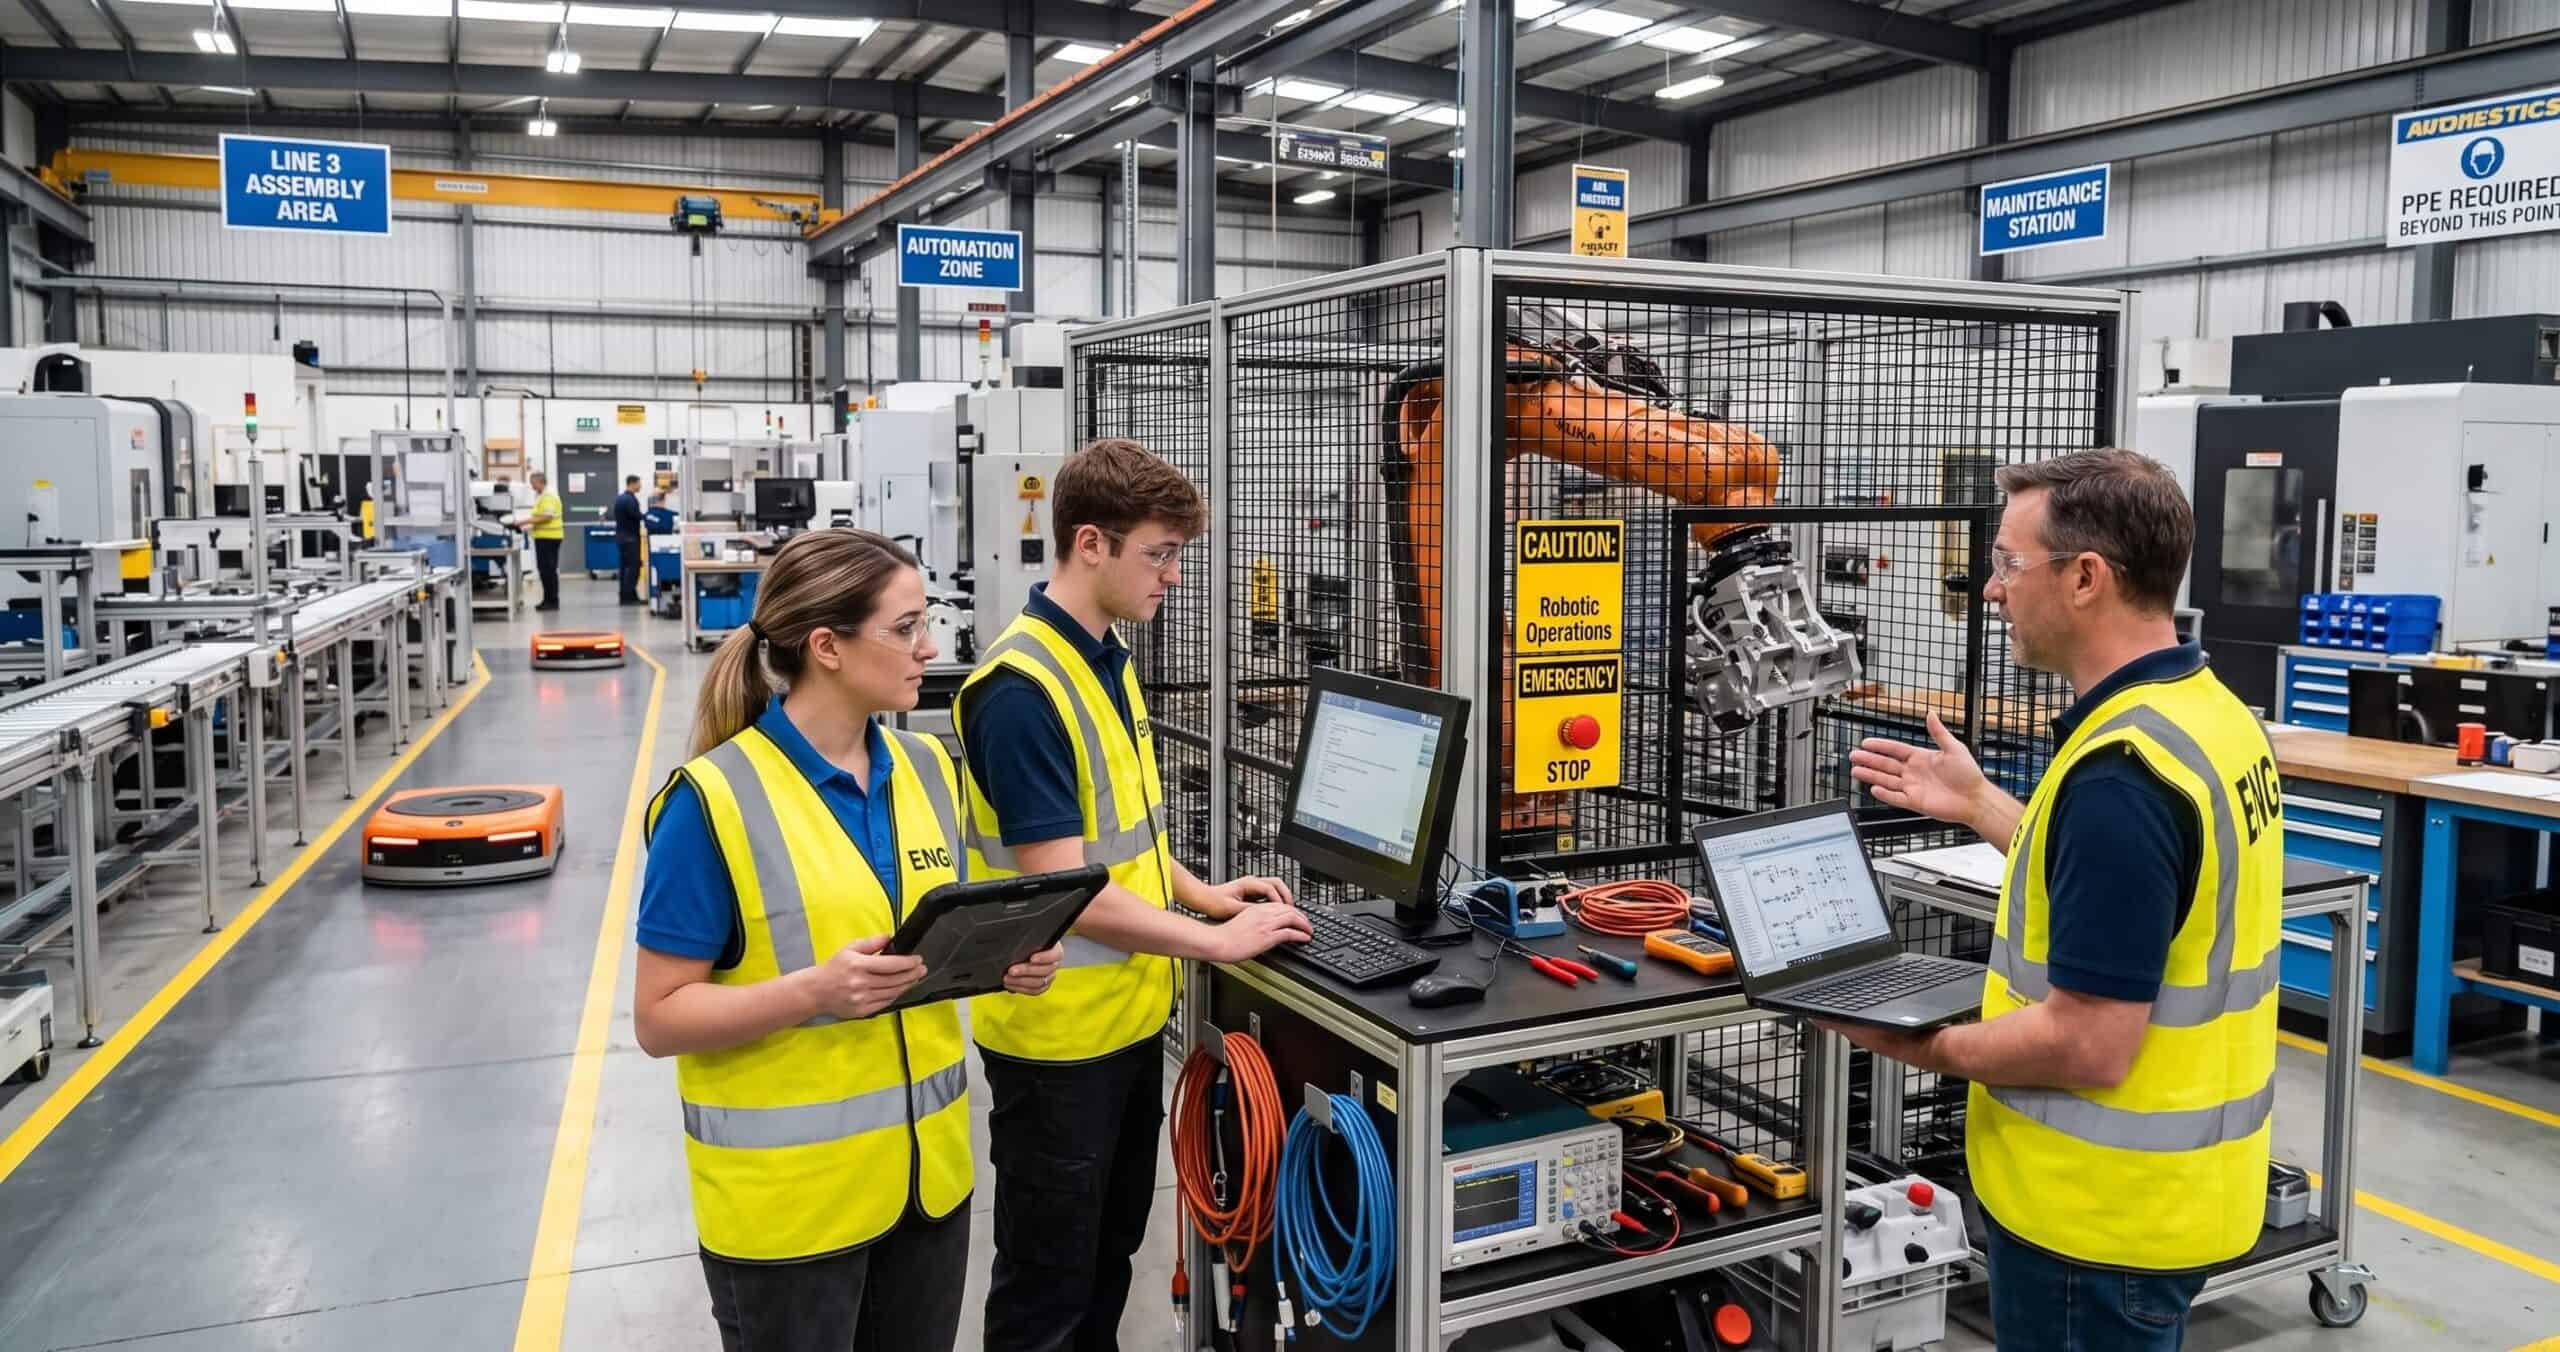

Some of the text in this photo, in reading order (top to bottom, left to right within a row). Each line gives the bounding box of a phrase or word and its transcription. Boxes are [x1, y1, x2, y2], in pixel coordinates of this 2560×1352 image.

[271, 149, 341, 175] LINE 3
[245, 173, 365, 200] ASSEMBLY
[1986, 180, 2102, 219] MAINTENANCE
[2402, 175, 2560, 216] PPE REQUIRED
[276, 200, 338, 223] AREA
[2008, 208, 2076, 239] STATION
[2400, 214, 2463, 237] BEYOND
[2469, 208, 2506, 229] THIS
[906, 237, 1015, 260] AUTOMATION
[939, 259, 984, 278] ZONE
[1524, 531, 1617, 559] CAUTION:
[1540, 595, 1600, 617] Robotic
[1526, 620, 1612, 648] Operations
[1522, 665, 1616, 693] EMERGENCY
[1547, 759, 1591, 783] STOP
[2235, 755, 2280, 847] ENG
[908, 847, 951, 871] ENG
